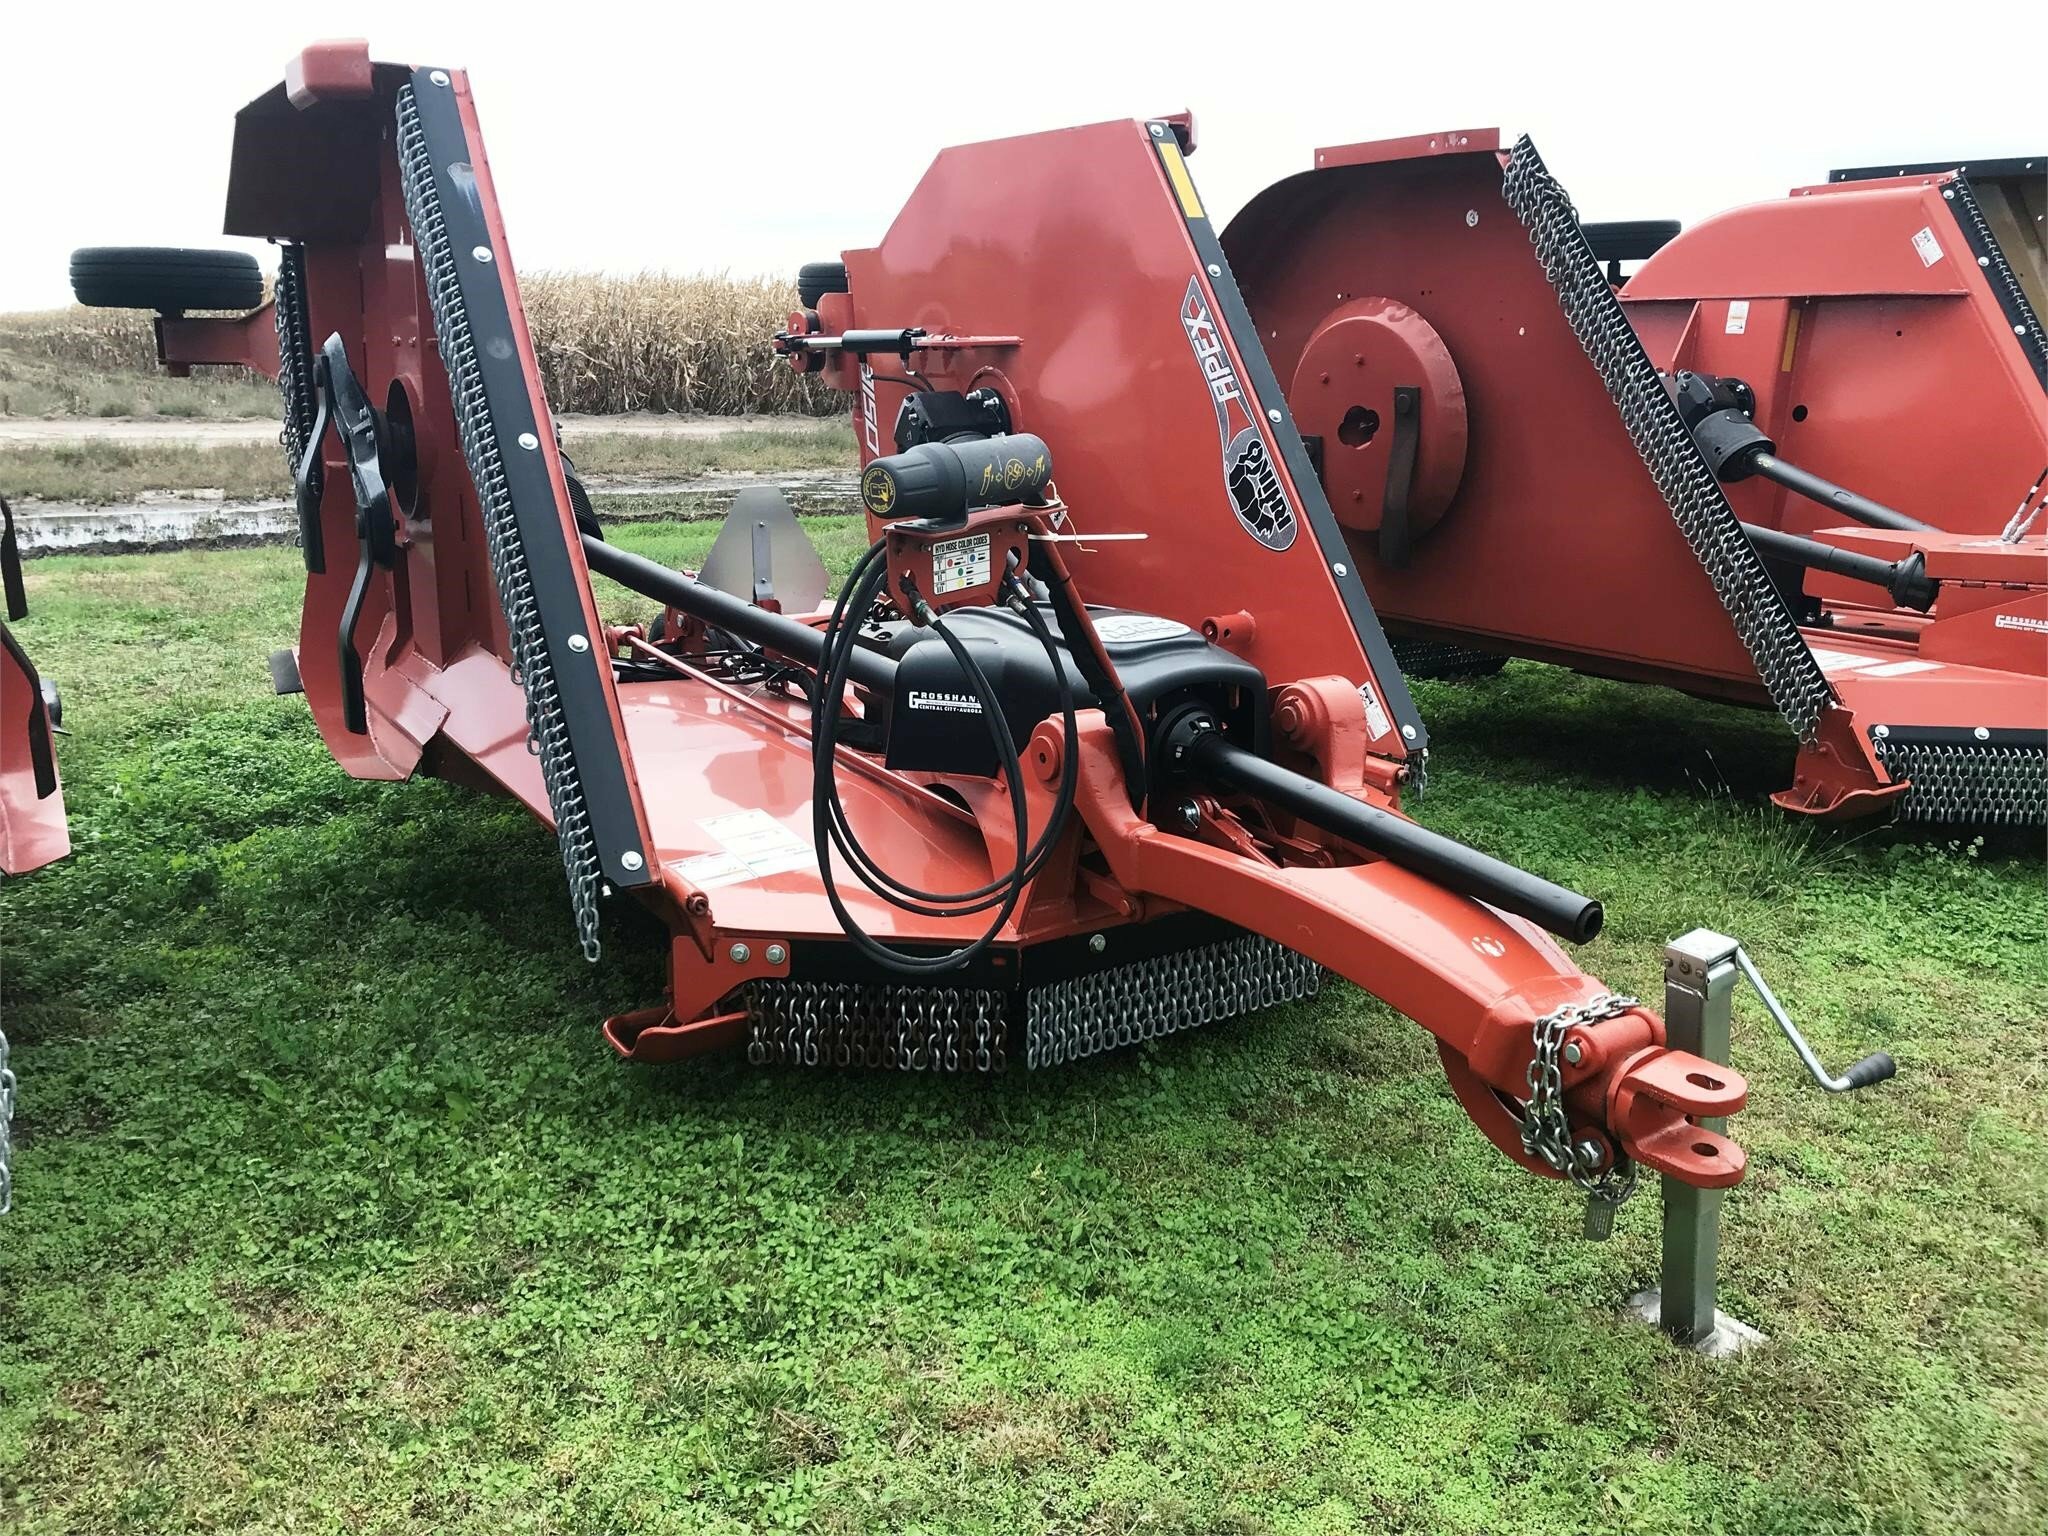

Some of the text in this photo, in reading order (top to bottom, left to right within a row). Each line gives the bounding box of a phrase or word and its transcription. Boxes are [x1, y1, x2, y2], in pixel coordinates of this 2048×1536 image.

[1184, 307, 1240, 403] APEX
[935, 535, 988, 554] HYD HOSE COLOR CODES
[918, 704, 943, 712] CENTRAL
